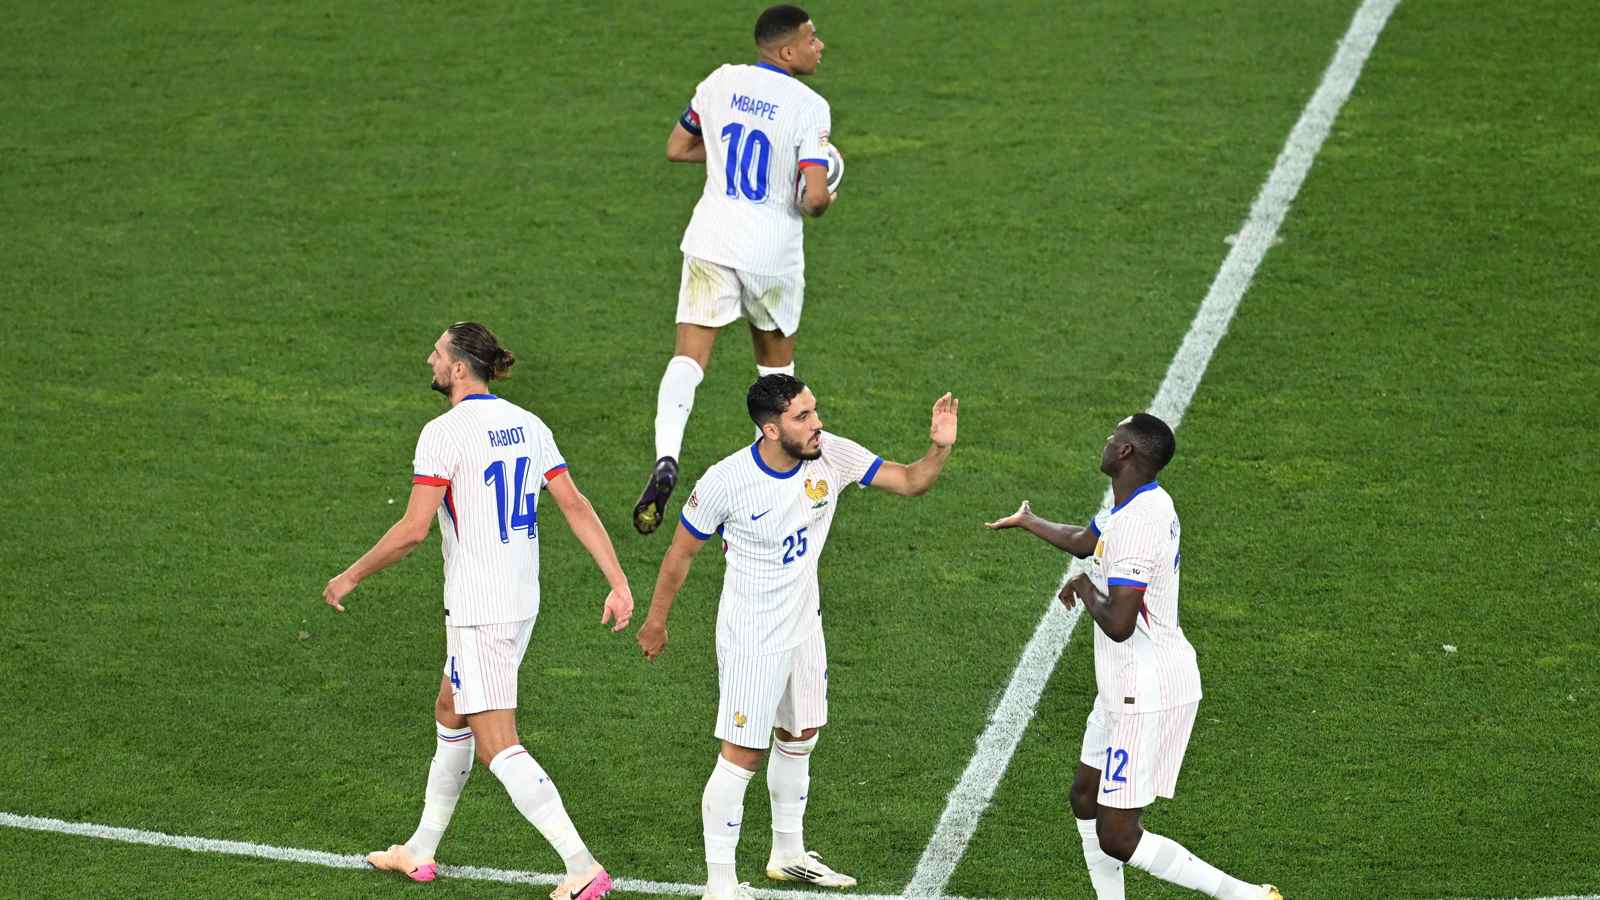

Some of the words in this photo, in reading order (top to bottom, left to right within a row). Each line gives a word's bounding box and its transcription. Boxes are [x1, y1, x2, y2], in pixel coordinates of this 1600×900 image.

[730, 93, 780, 121] MBAPPE
[721, 122, 773, 204] 10
[487, 426, 526, 447] RABIOT
[484, 456, 538, 544] 14
[782, 527, 808, 566] 25
[1105, 746, 1130, 783] 12
